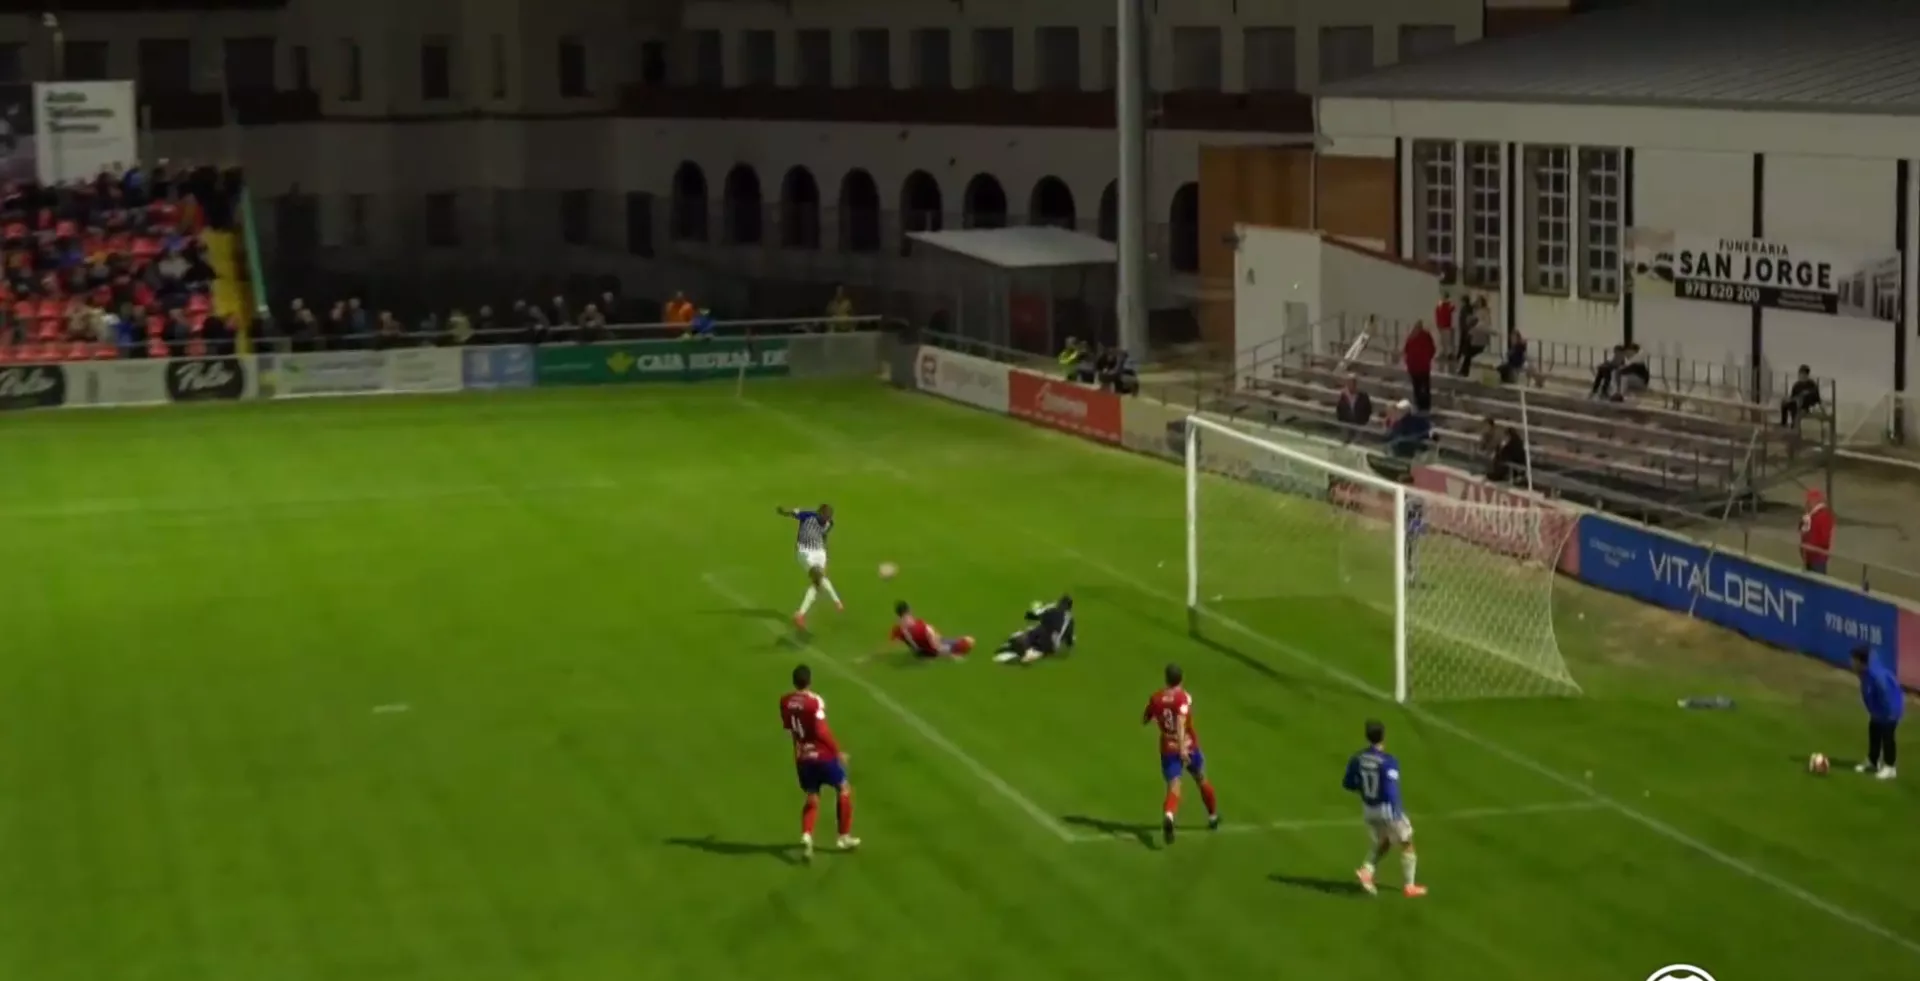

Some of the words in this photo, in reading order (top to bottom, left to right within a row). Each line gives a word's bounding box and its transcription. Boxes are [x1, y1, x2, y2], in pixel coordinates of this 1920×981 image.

[1718, 239, 1789, 256] FUNERARIA
[1680, 250, 1732, 279] SAN
[1743, 256, 1832, 289] JORGE
[1684, 281, 1707, 297] 978
[1710, 284, 1733, 299] 620
[1736, 286, 1760, 302] 200
[1649, 548, 1805, 627] VITALDENT
